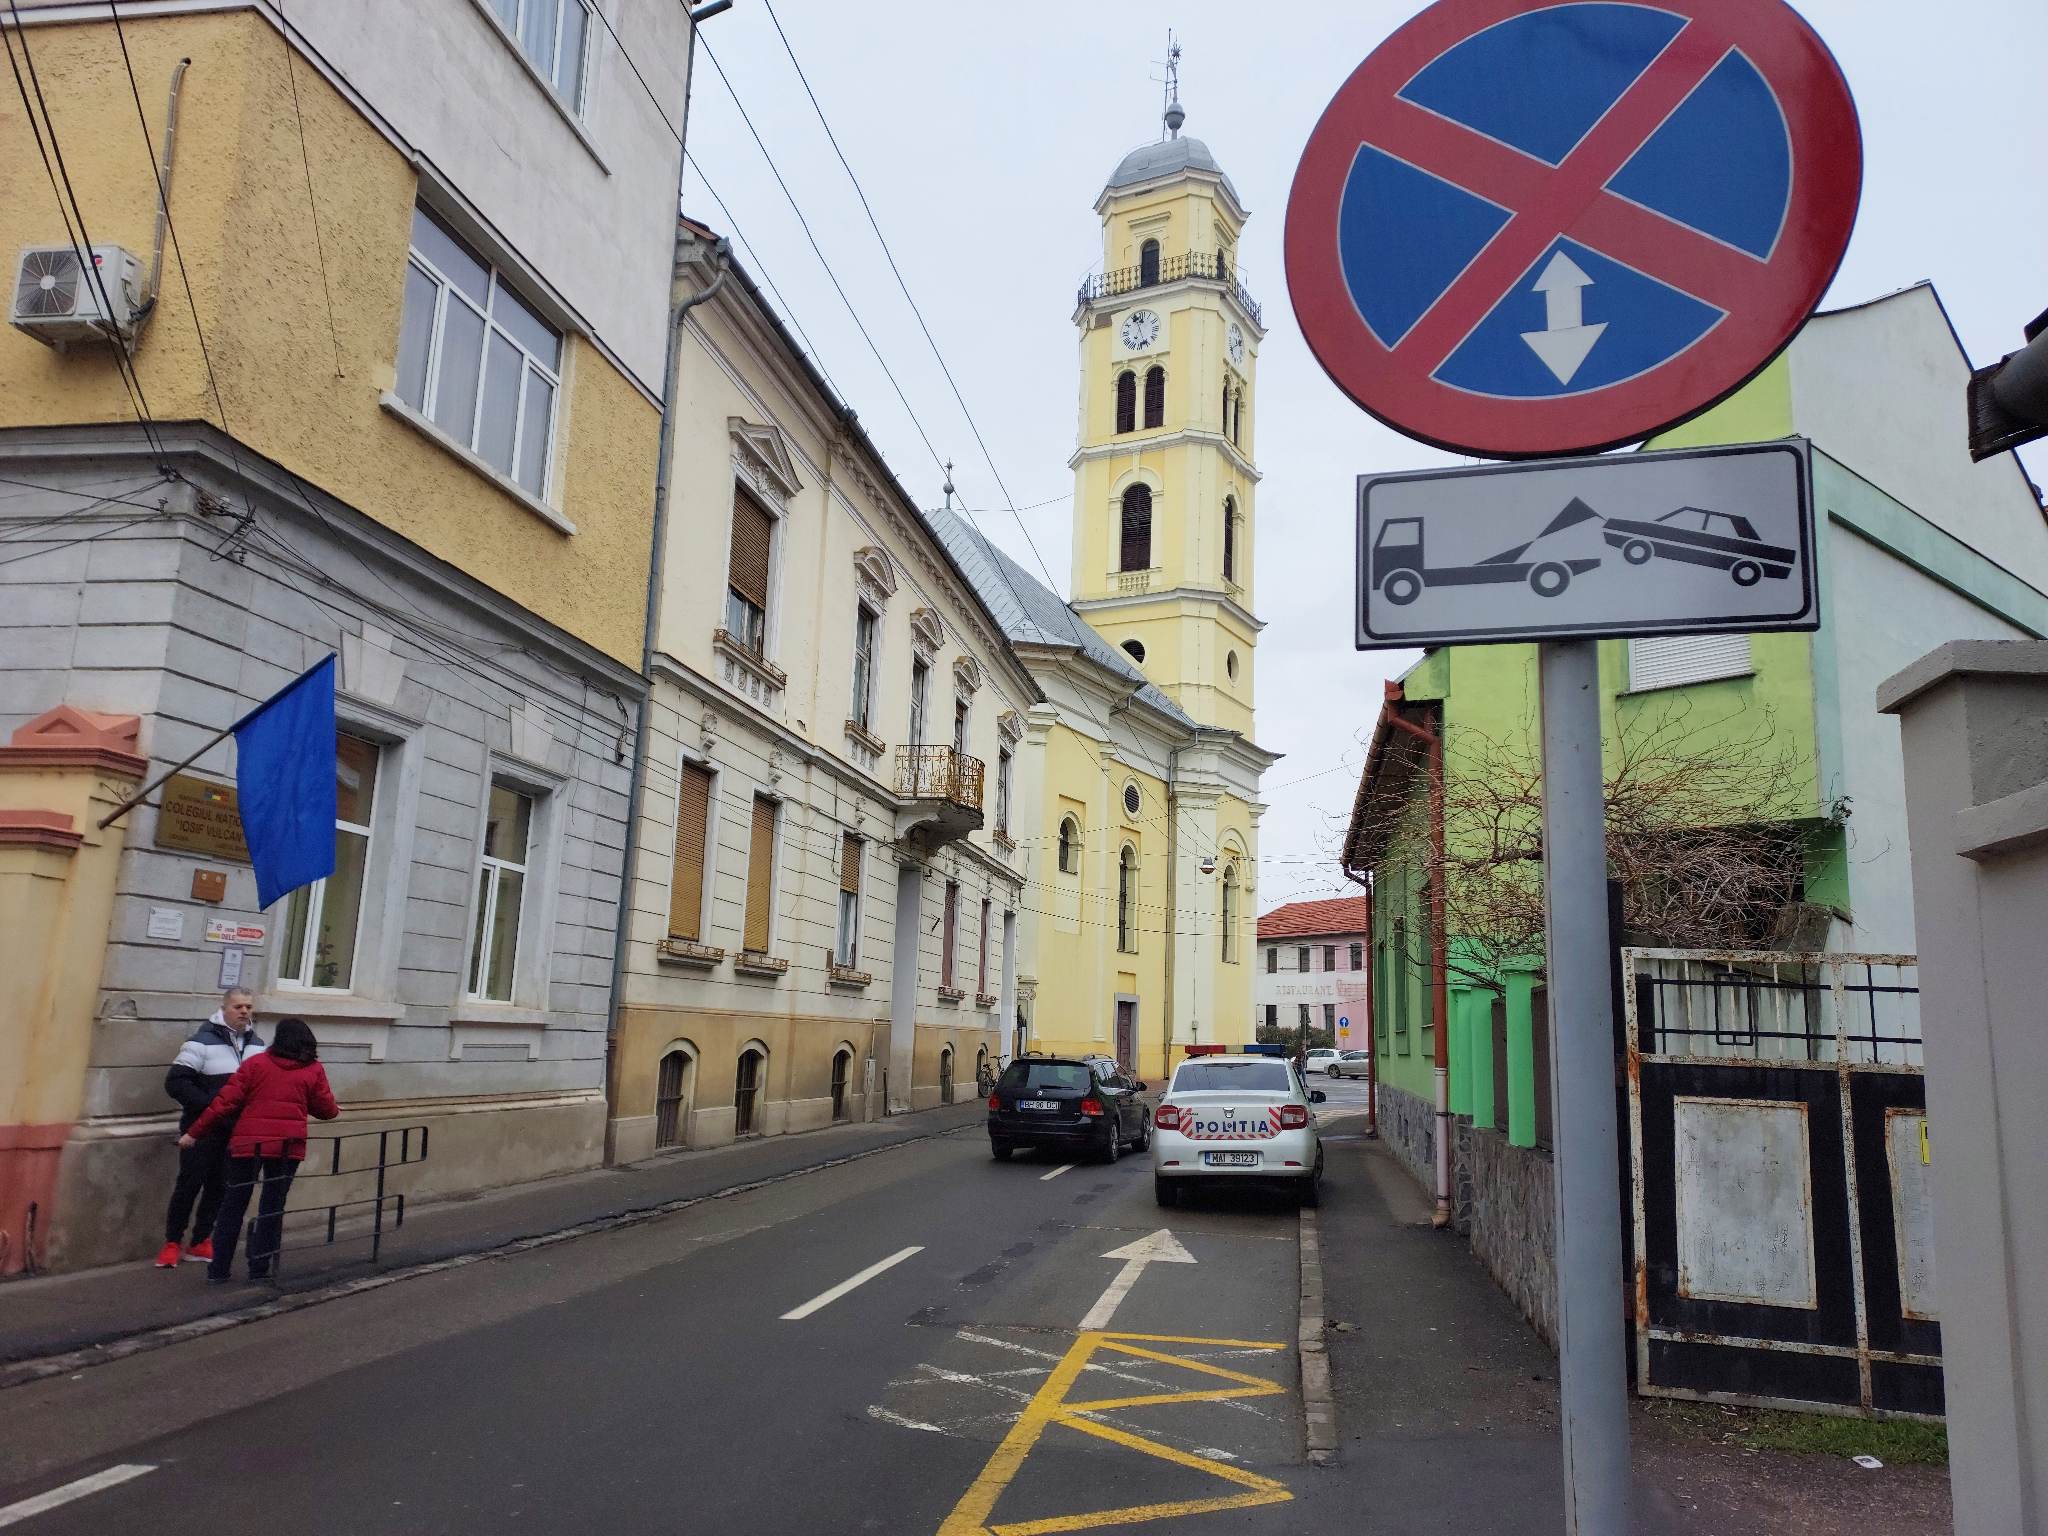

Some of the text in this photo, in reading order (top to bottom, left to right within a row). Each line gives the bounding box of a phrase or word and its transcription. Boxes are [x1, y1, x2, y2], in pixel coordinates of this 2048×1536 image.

[165, 801, 214, 821] COLEGIUL
[1212, 1153, 1255, 1163] MAI 39123
